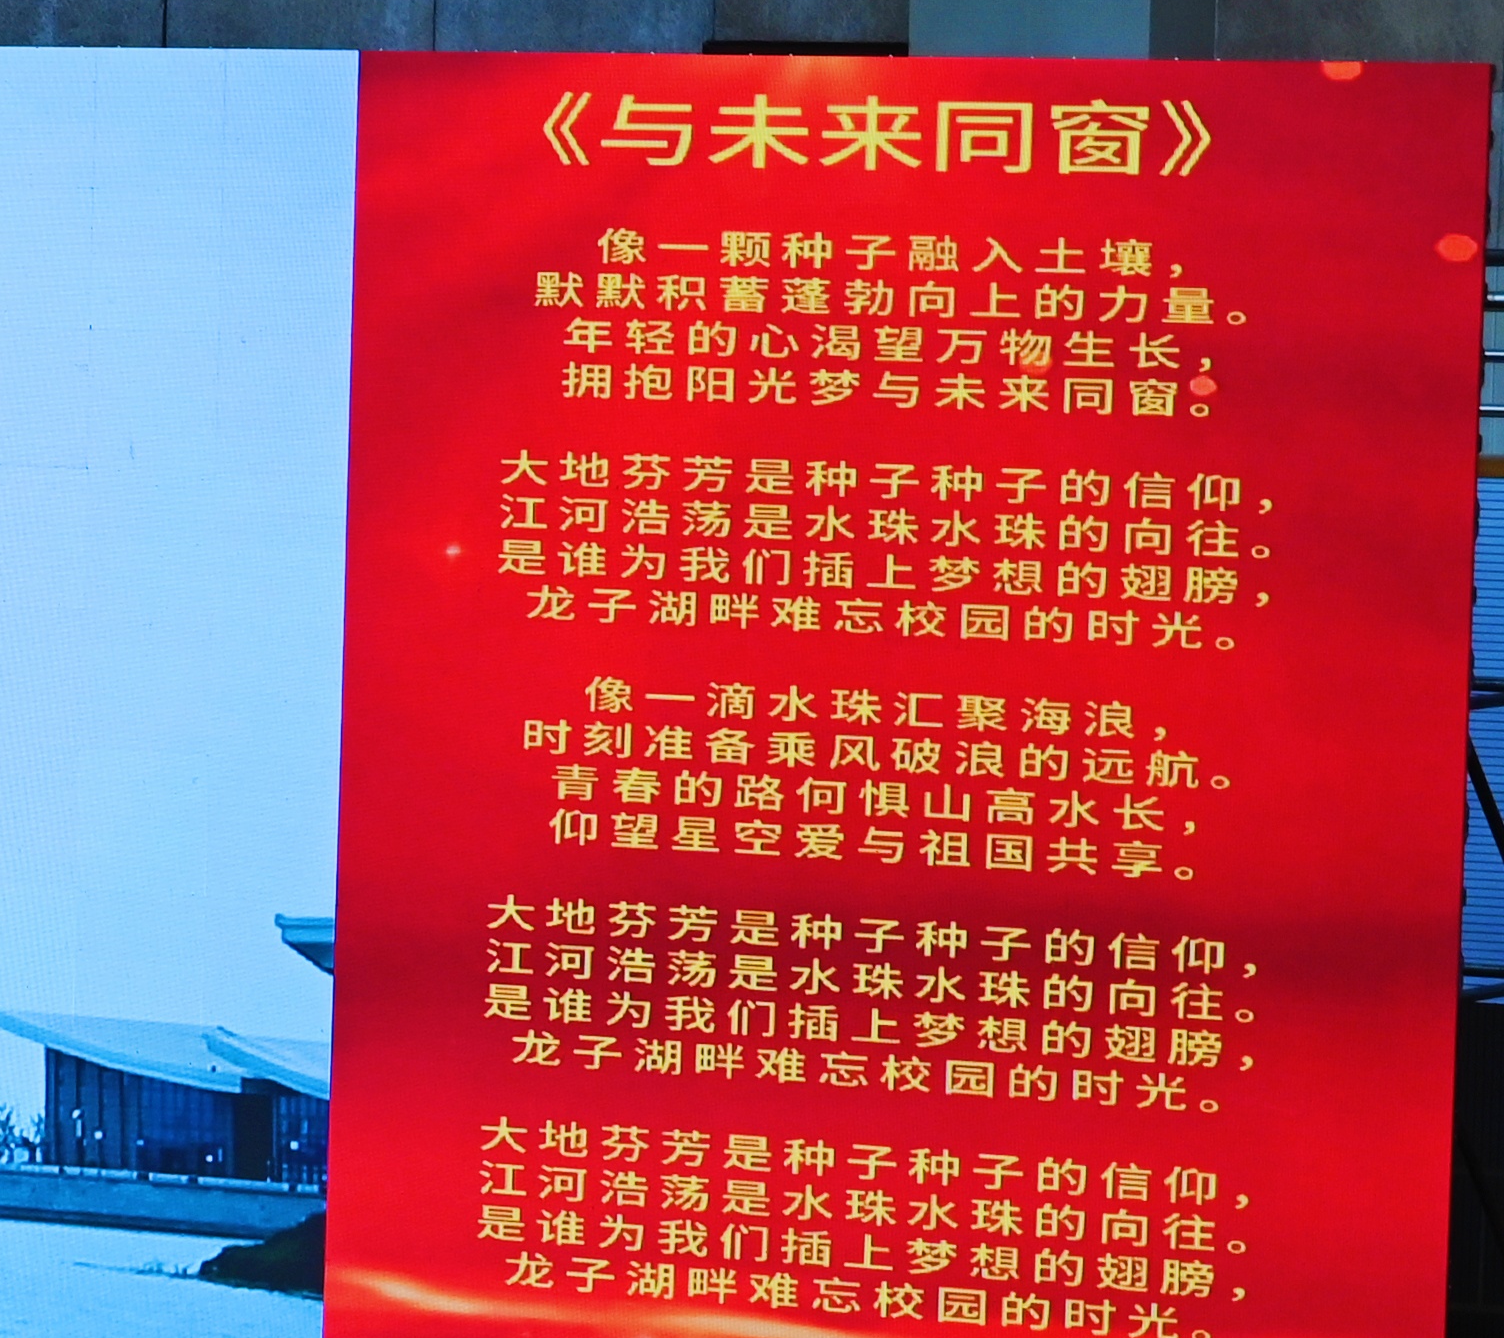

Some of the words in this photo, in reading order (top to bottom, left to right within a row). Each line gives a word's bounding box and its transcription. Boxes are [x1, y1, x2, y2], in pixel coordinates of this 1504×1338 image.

[543, 91, 1211, 177] 《与未来同窗》
[597, 227, 1183, 278] 像一颗种子融入土壤，
[535, 271, 1247, 325] 默默积蓄蓬勃向上的力量。
[563, 316, 1211, 372] 年轻的心渴望万物生长，
[561, 361, 1213, 418] 拥抱阳光梦与未来同窗。
[501, 449, 1273, 514] 大地芬芳是种子种子的信仰，
[500, 493, 1270, 559] 江河浩荡是水珠水珠的向往。
[498, 539, 1269, 607] 是谁为我们插上梦想的翅膀，
[527, 584, 1235, 650] 龙子湖畔难忘校园的时光。
[584, 676, 1167, 741] 像一滴水珠汇聚海浪，
[523, 719, 1230, 790] 时刻准备乘风破浪的远航。
[551, 763, 1196, 835] 青春的路何惧山高水长，
[549, 808, 1194, 880] 仰望星空爱与祖国共享。
[487, 894, 1257, 978] 大地芬芳是种子种子的信仰，
[487, 938, 1254, 1023] 江河浩荡是水珠水珠的向往。
[484, 983, 1254, 1071] 是谁为我们插上梦想的翅膀，
[512, 1029, 1219, 1113] 龙子湖畔难忘校园的时光。
[481, 1116, 1249, 1208] 大地芬芳是种子种子的信仰，
[479, 1160, 1246, 1254] 江河浩荡是水珠水珠的向往。
[477, 1204, 1246, 1300] 是谁为我们插上梦想的翅膀，
